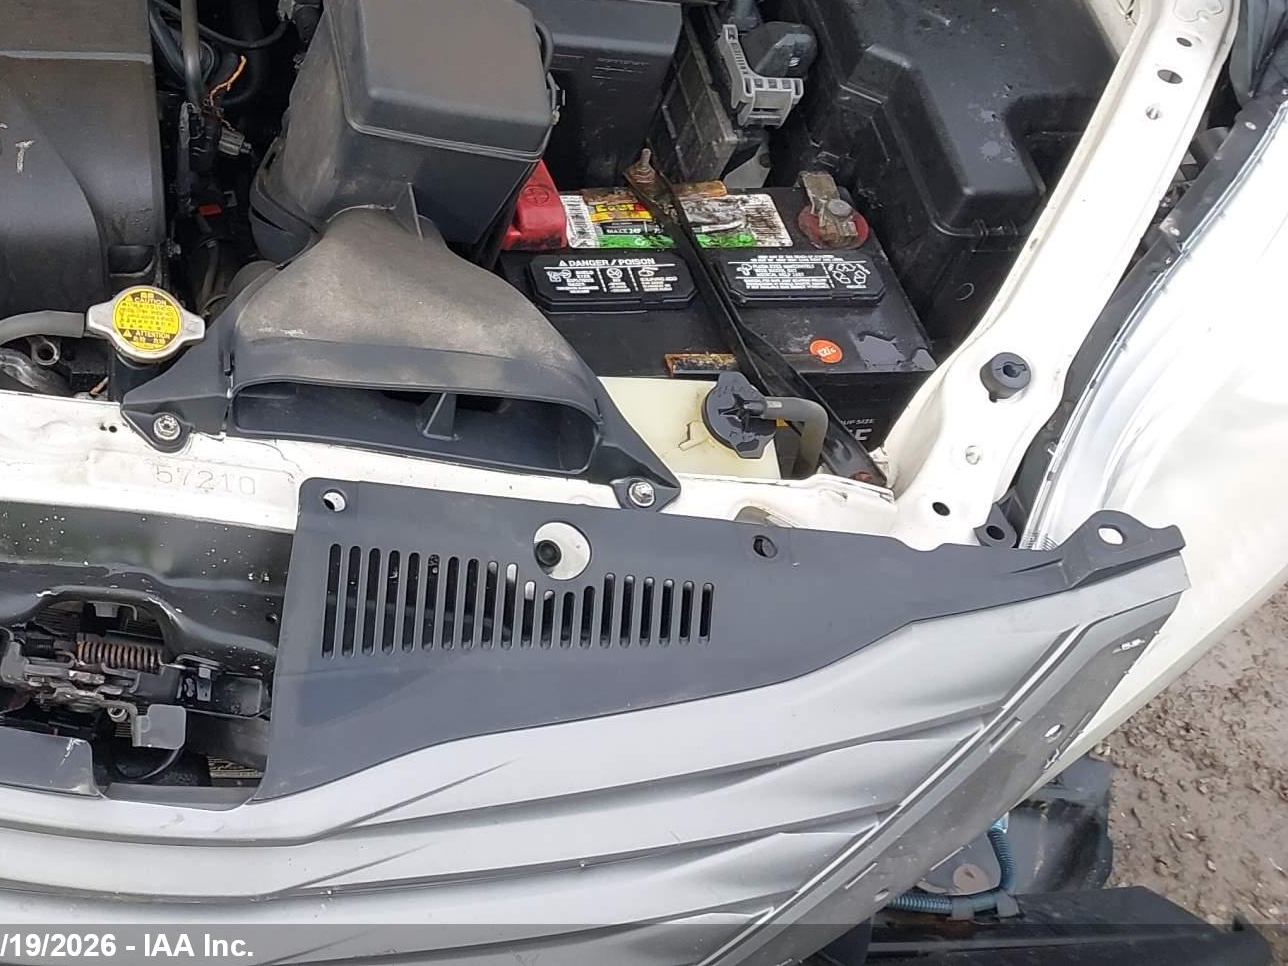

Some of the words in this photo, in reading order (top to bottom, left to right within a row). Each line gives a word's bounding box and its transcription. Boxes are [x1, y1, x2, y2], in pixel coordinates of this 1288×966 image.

[568, 259, 609, 267] DANGER
[618, 258, 656, 266] POISON
[134, 297, 167, 306] CAUTION
[135, 329, 170, 339] ATTENTION
